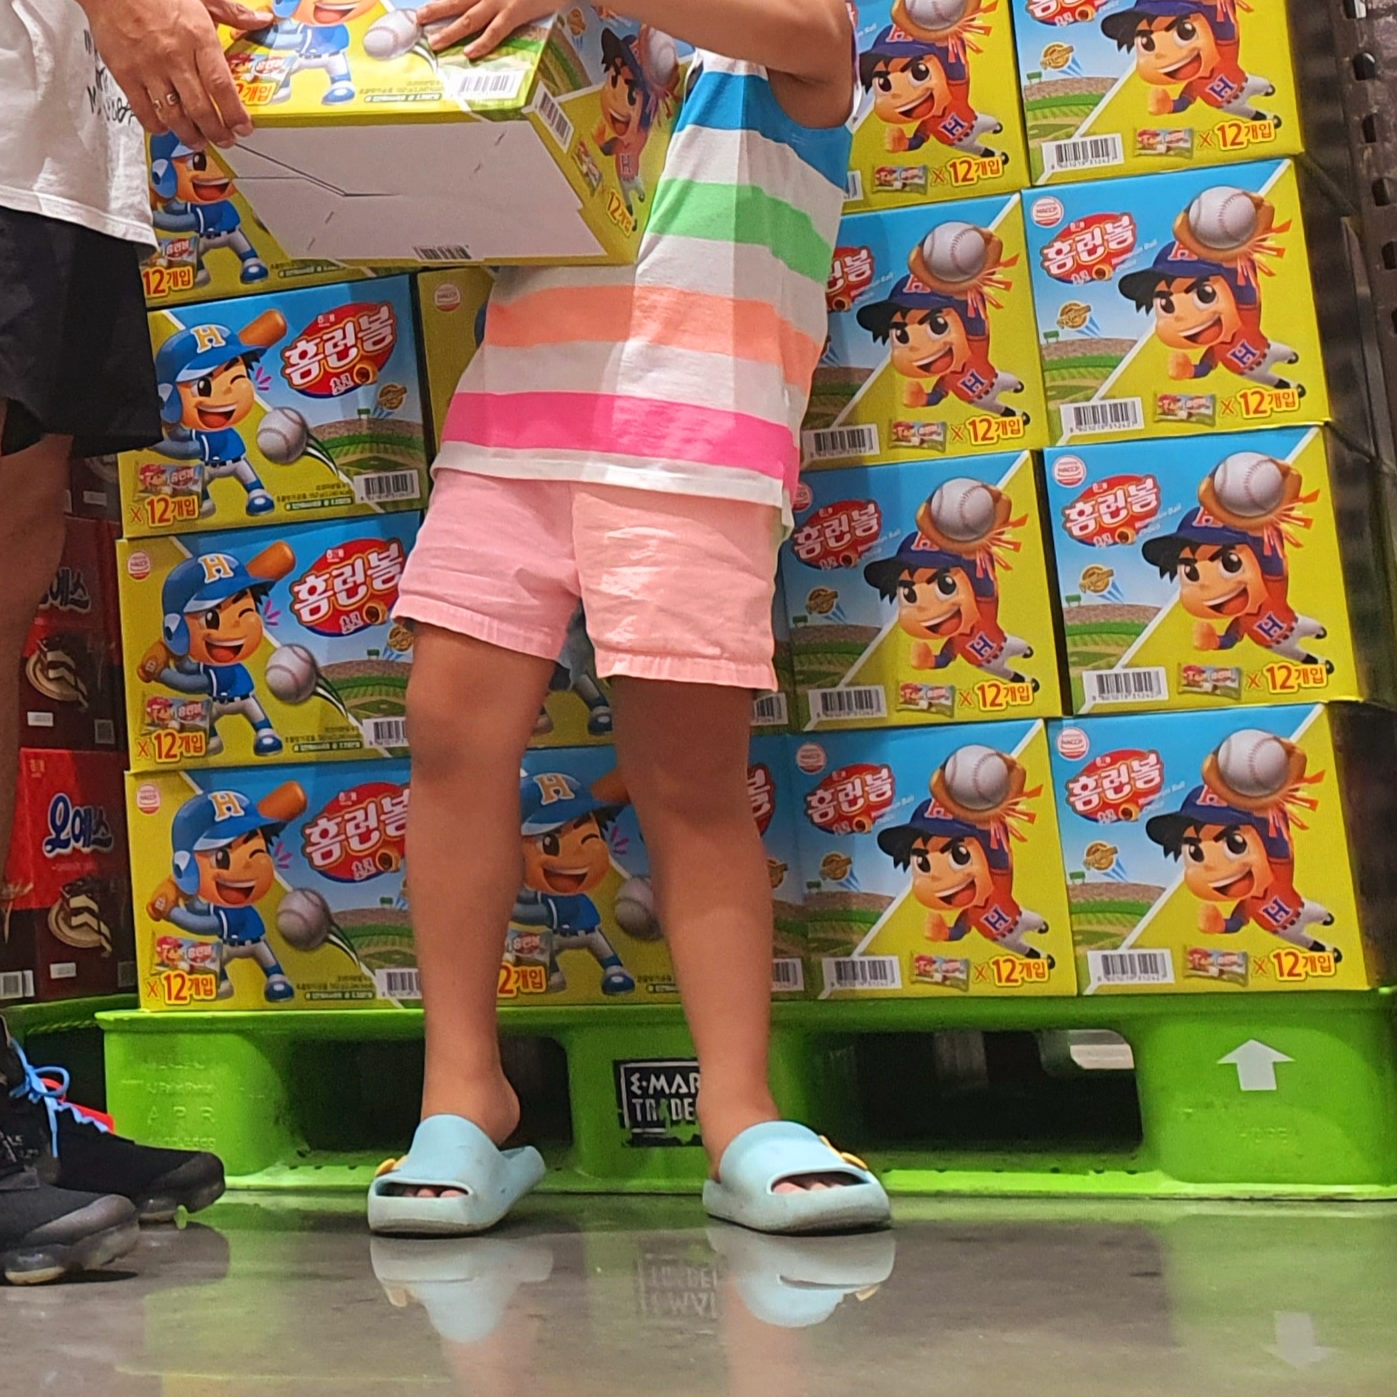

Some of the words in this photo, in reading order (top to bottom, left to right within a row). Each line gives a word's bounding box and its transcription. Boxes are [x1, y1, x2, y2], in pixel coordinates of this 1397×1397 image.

[1217, 121, 1277, 150] 12개입
[948, 158, 1002, 186] 12개입
[1042, 214, 1137, 277] 홈런볼
[141, 268, 194, 295] 12개입
[283, 304, 395, 387] 홈런볼
[1240, 389, 1300, 417] 12개입
[969, 417, 1024, 444] 12개입
[146, 496, 198, 526] 12개입
[1063, 475, 1159, 537] 홈런볼
[792, 502, 880, 564] 홈런볼
[292, 549, 404, 622] 홈런볼
[1266, 663, 1326, 691] 12개입
[976, 681, 1033, 710] 12개입
[152, 731, 206, 762] 12개입
[806, 765, 895, 825] 홈런볼
[1069, 753, 1161, 812] 홈런볼
[43, 793, 115, 858] 오예스
[497, 965, 546, 996] 2개입
[992, 957, 1049, 984] 12개입
[1274, 950, 1335, 982] 12개입
[162, 972, 217, 1004] 12개입
[632, 1097, 696, 1122] TRDE
